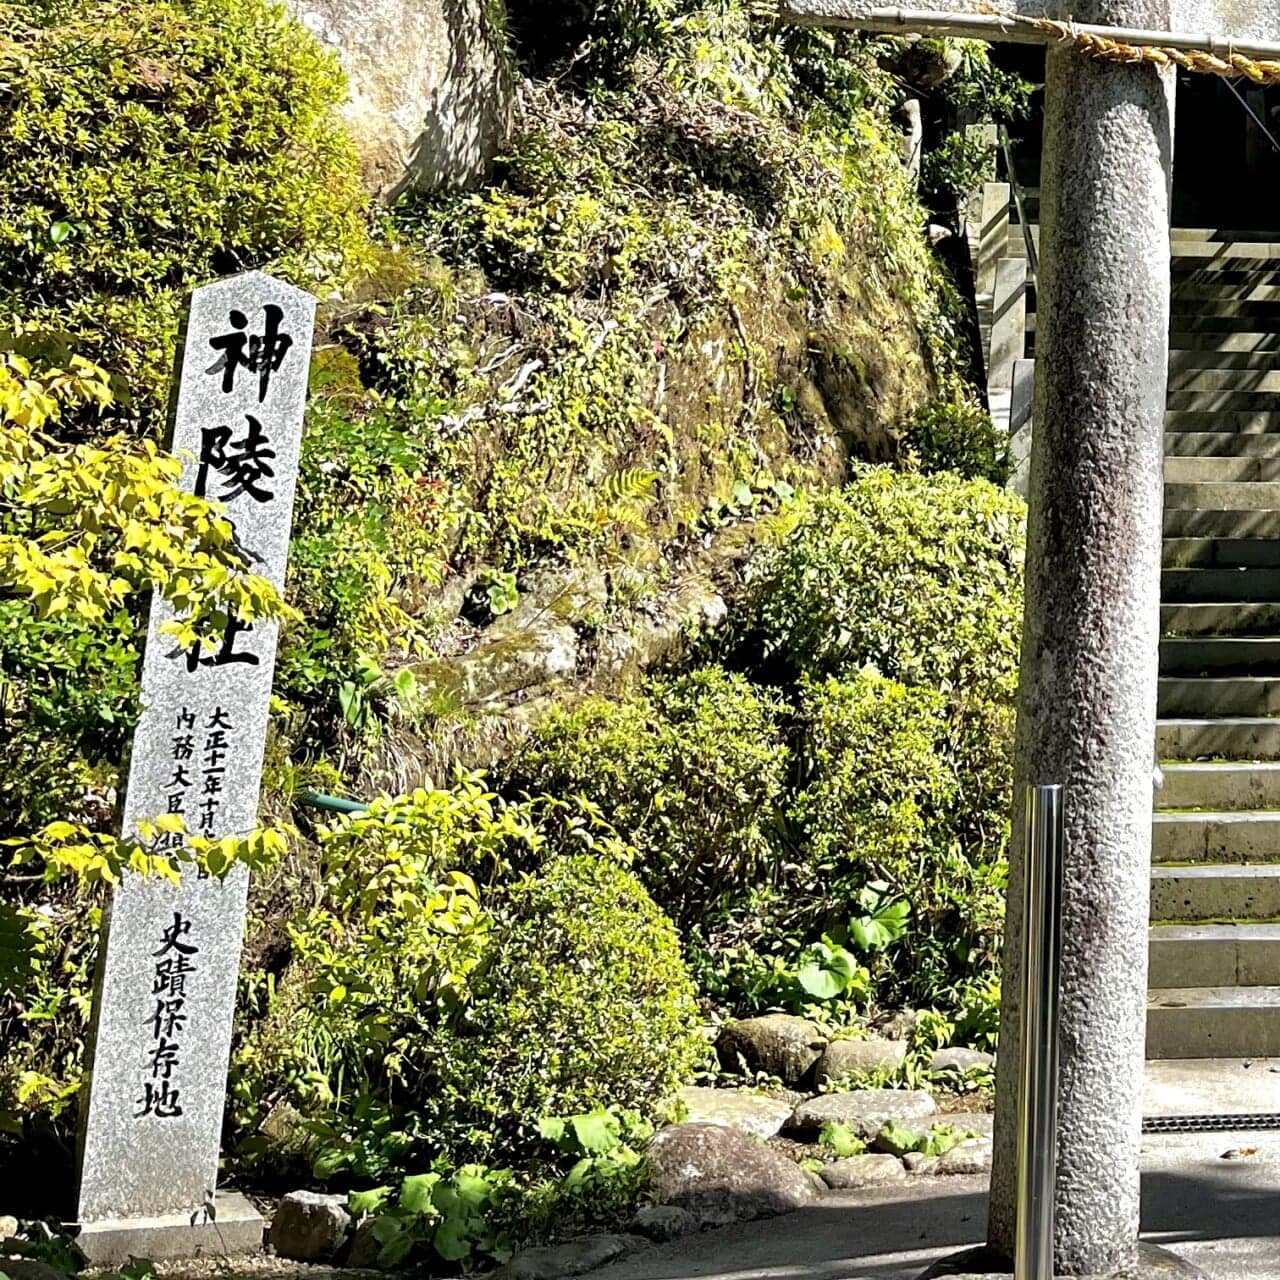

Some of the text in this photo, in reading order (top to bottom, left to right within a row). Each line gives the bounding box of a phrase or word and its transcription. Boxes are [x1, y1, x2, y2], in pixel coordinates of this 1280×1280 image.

[164, 303, 294, 674] 神陵社
[133, 912, 198, 1119] 史蹟保存地
